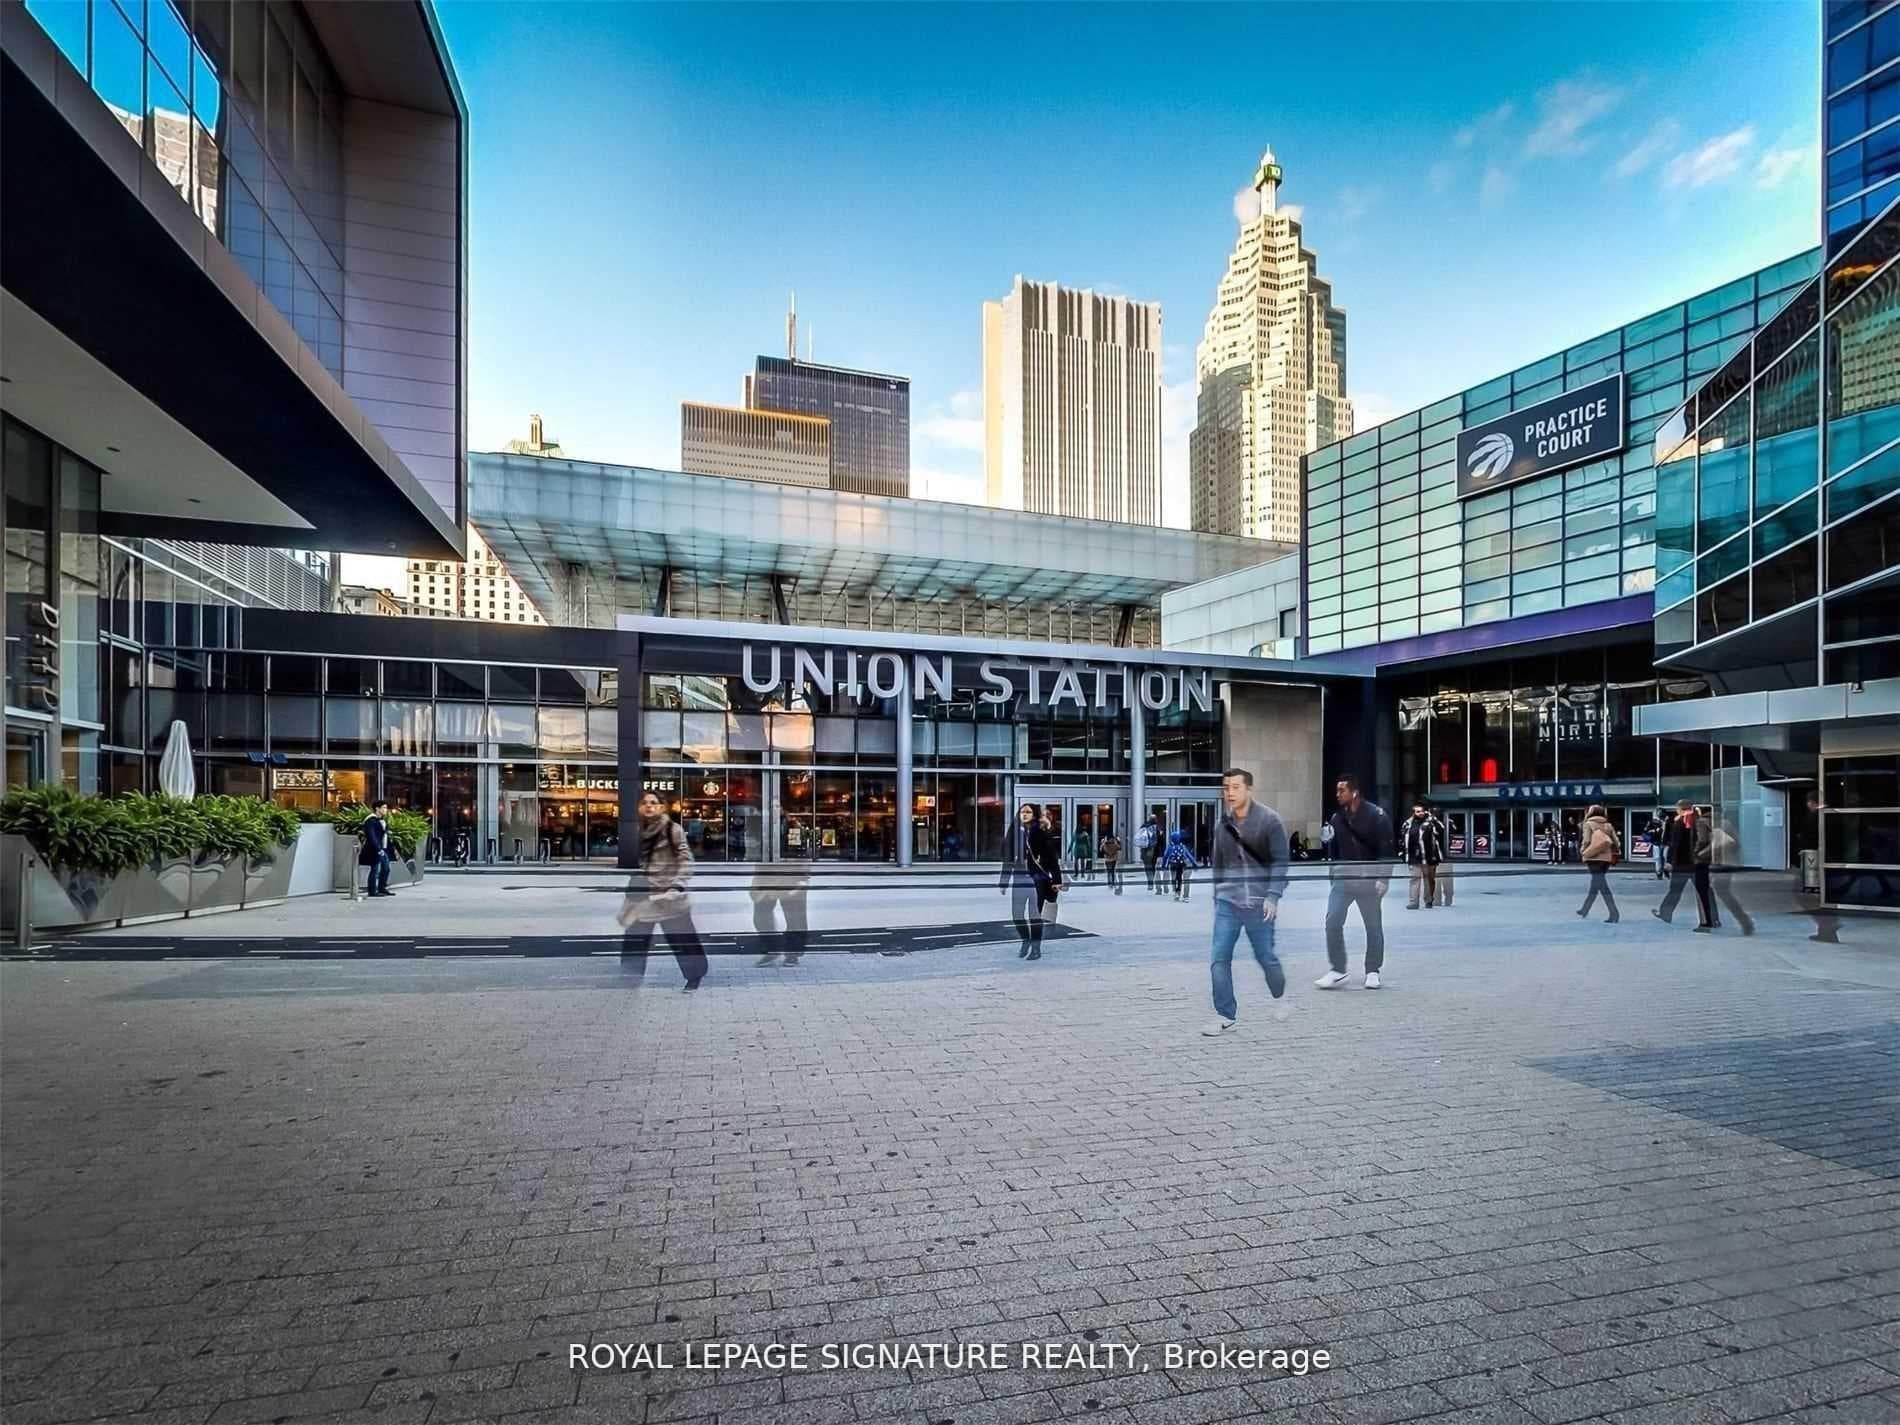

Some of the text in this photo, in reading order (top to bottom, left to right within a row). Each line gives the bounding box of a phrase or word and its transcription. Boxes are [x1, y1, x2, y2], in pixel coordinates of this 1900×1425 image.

[1524, 397, 1607, 443] PRACTICE
[1537, 424, 1592, 458] COURT
[742, 644, 1213, 713] UNION STATION
